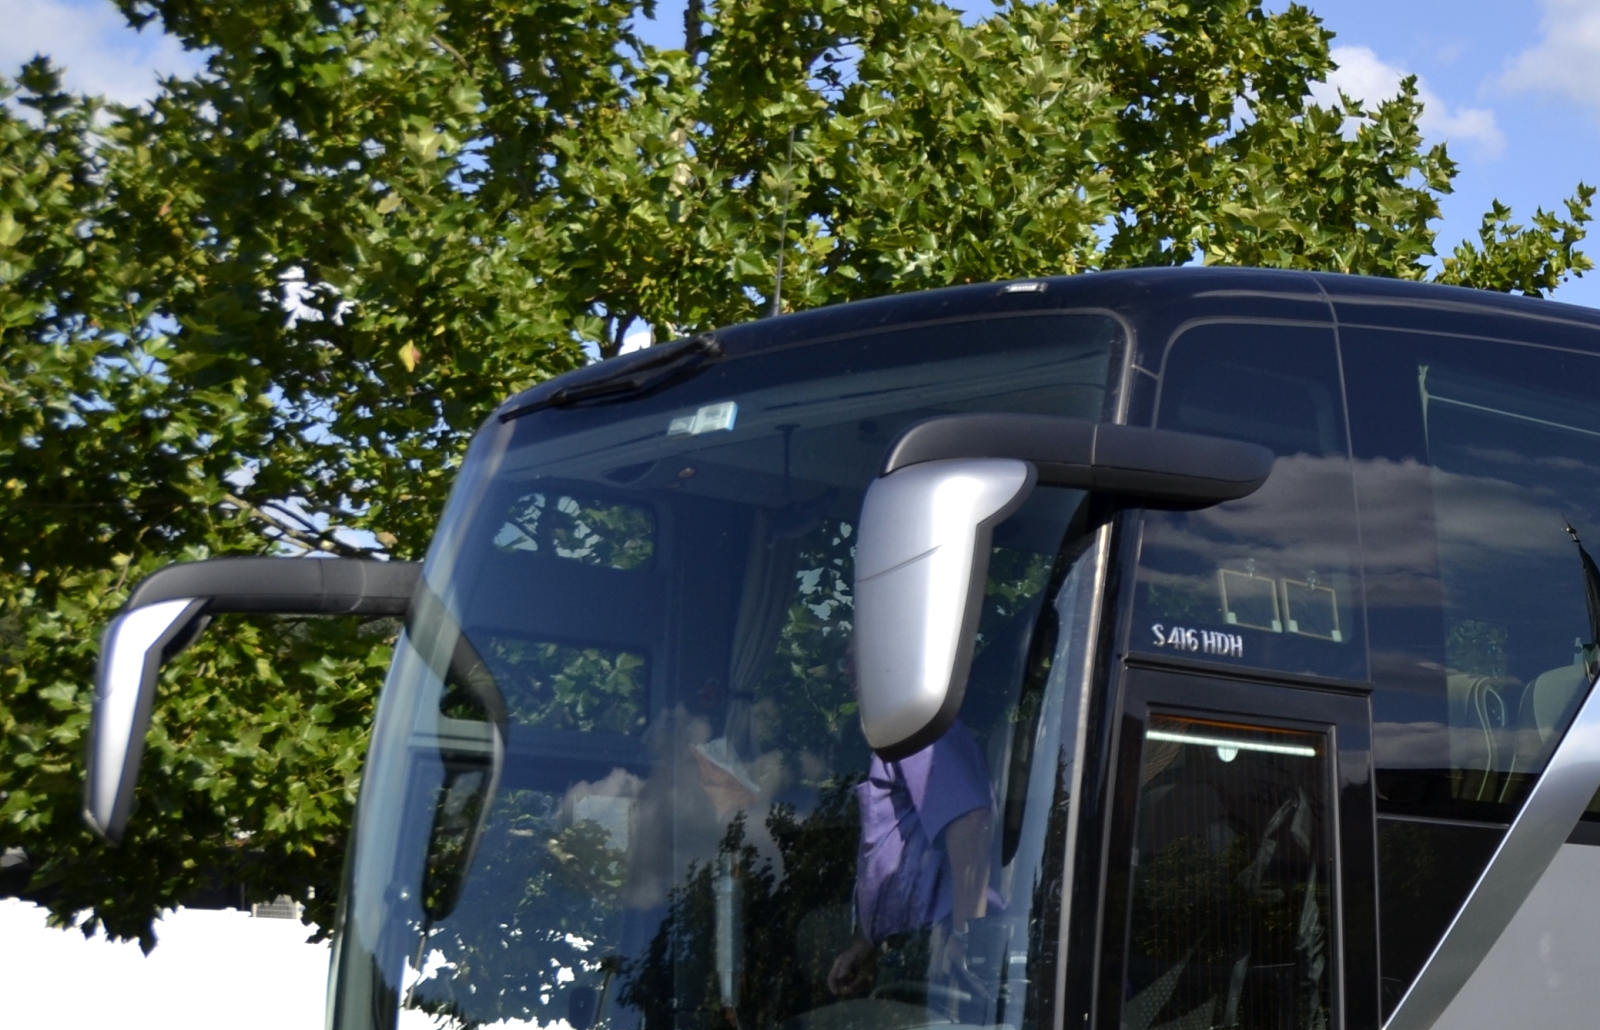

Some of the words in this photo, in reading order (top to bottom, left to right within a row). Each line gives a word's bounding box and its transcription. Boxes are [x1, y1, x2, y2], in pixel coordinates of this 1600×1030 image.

[1151, 623, 1166, 647] S
[1168, 626, 1199, 652] 416
[1200, 630, 1244, 658] HDH
